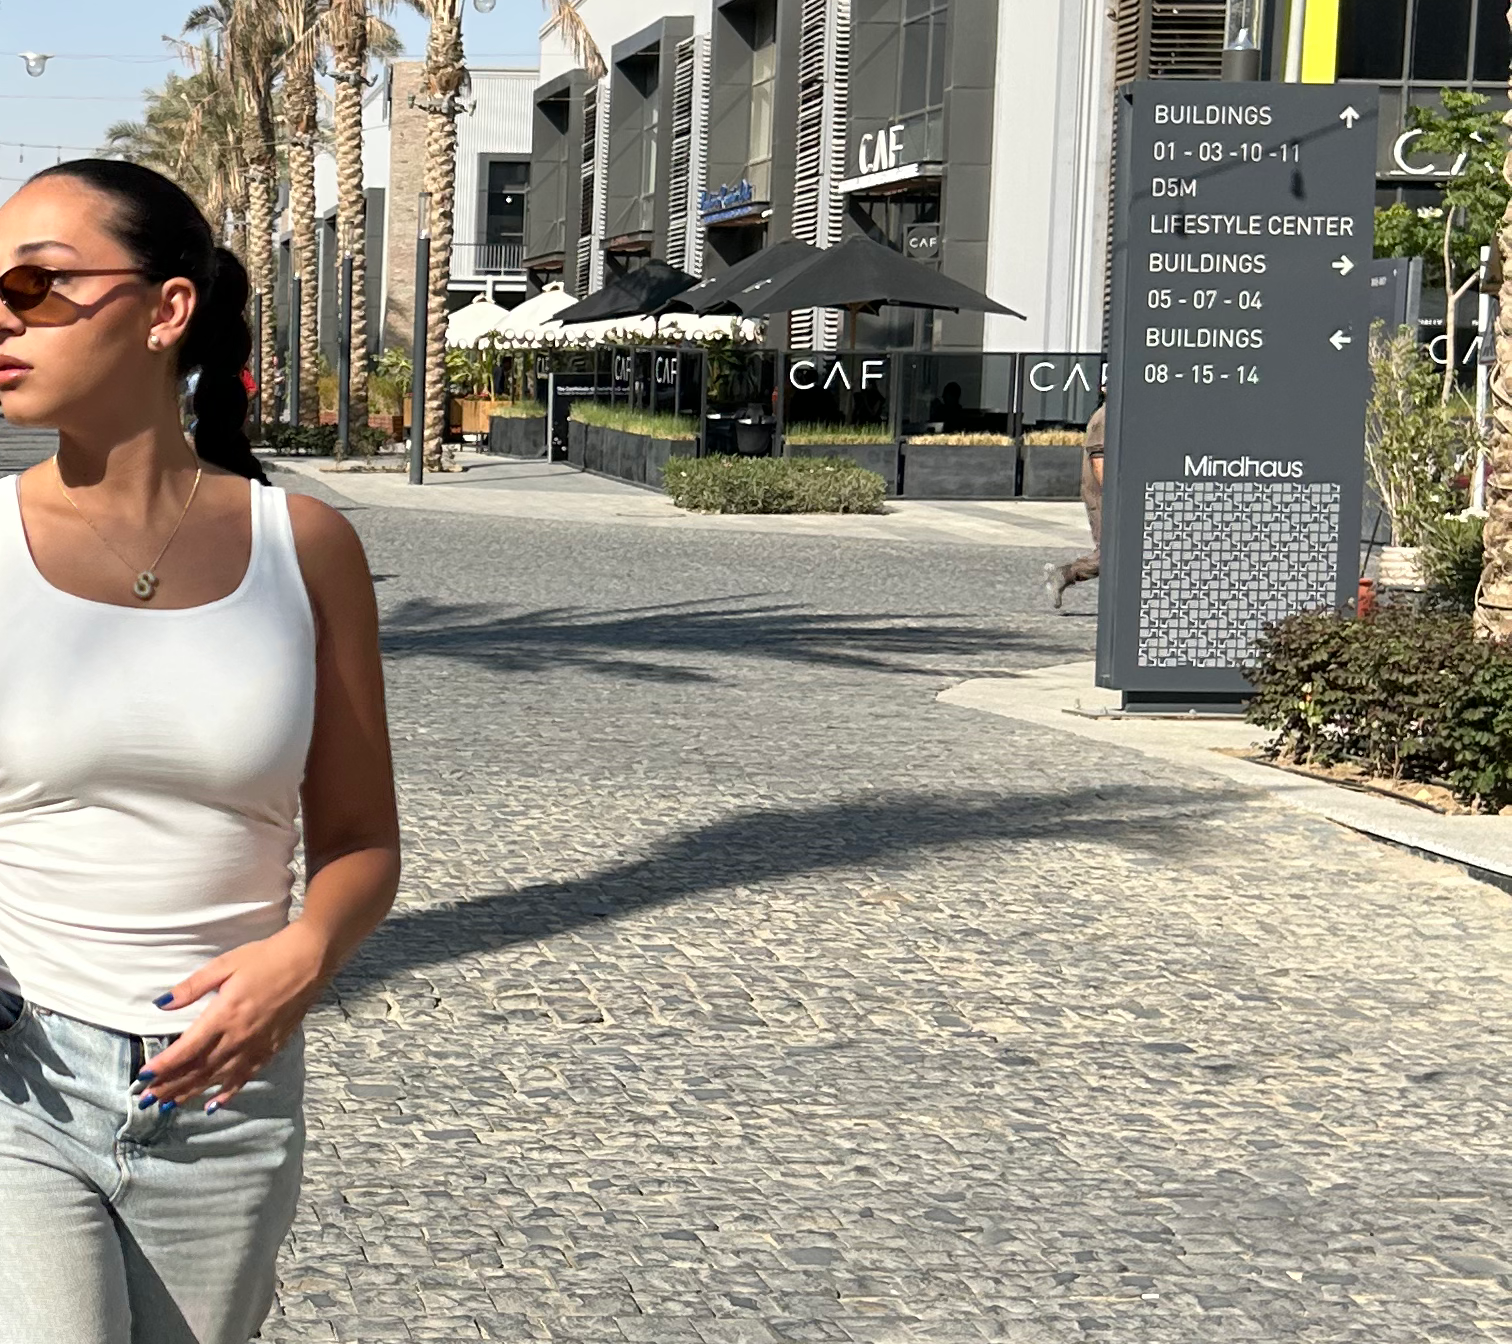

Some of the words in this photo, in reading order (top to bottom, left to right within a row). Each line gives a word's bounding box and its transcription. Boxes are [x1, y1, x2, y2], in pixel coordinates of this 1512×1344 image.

[1154, 104, 1273, 126] BUILDINGS
[859, 124, 905, 174] CAF
[1153, 141, 1175, 161] 01
[1199, 141, 1223, 162] 03
[1152, 177, 1197, 198] D5M
[1150, 213, 1262, 235] LIFESTYLE
[1267, 215, 1354, 237] CENTER
[909, 237, 937, 248] CAF
[1149, 252, 1267, 274] BUILDINGS
[1147, 289, 1172, 309] 05
[1193, 289, 1218, 310] 07
[1238, 290, 1263, 310] 04
[1145, 327, 1264, 349] BUILDINGS
[789, 360, 885, 391] CAF
[1144, 363, 1169, 384] 08
[1191, 364, 1214, 384] 15
[1236, 365, 1260, 385] 14
[1184, 455, 1304, 479] Mindhaus
